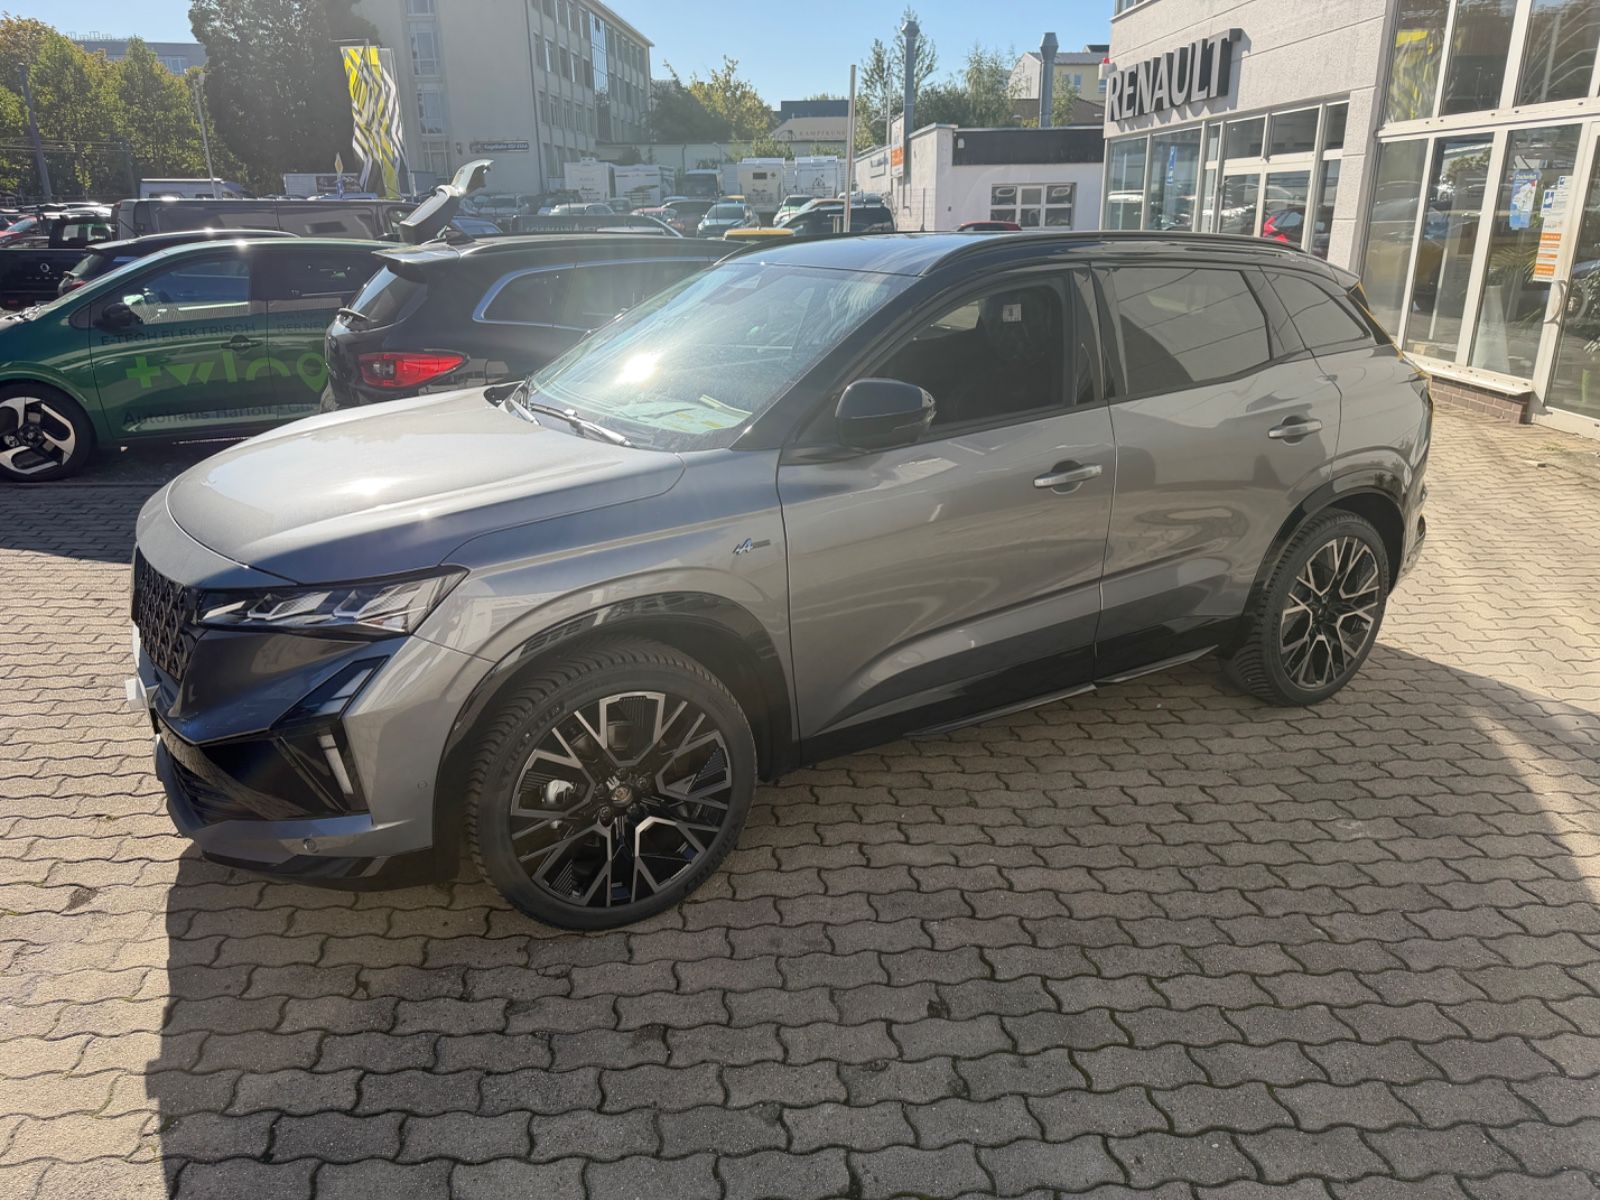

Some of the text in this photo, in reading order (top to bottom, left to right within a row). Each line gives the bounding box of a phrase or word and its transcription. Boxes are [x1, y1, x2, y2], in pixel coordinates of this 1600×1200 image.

[1107, 28, 1241, 121] RENAULT
[799, 130, 847, 138] KAMPFKUNS
[101, 323, 256, 346] E-TECH ELEKTRISCH
[122, 405, 208, 426] Autohaus
